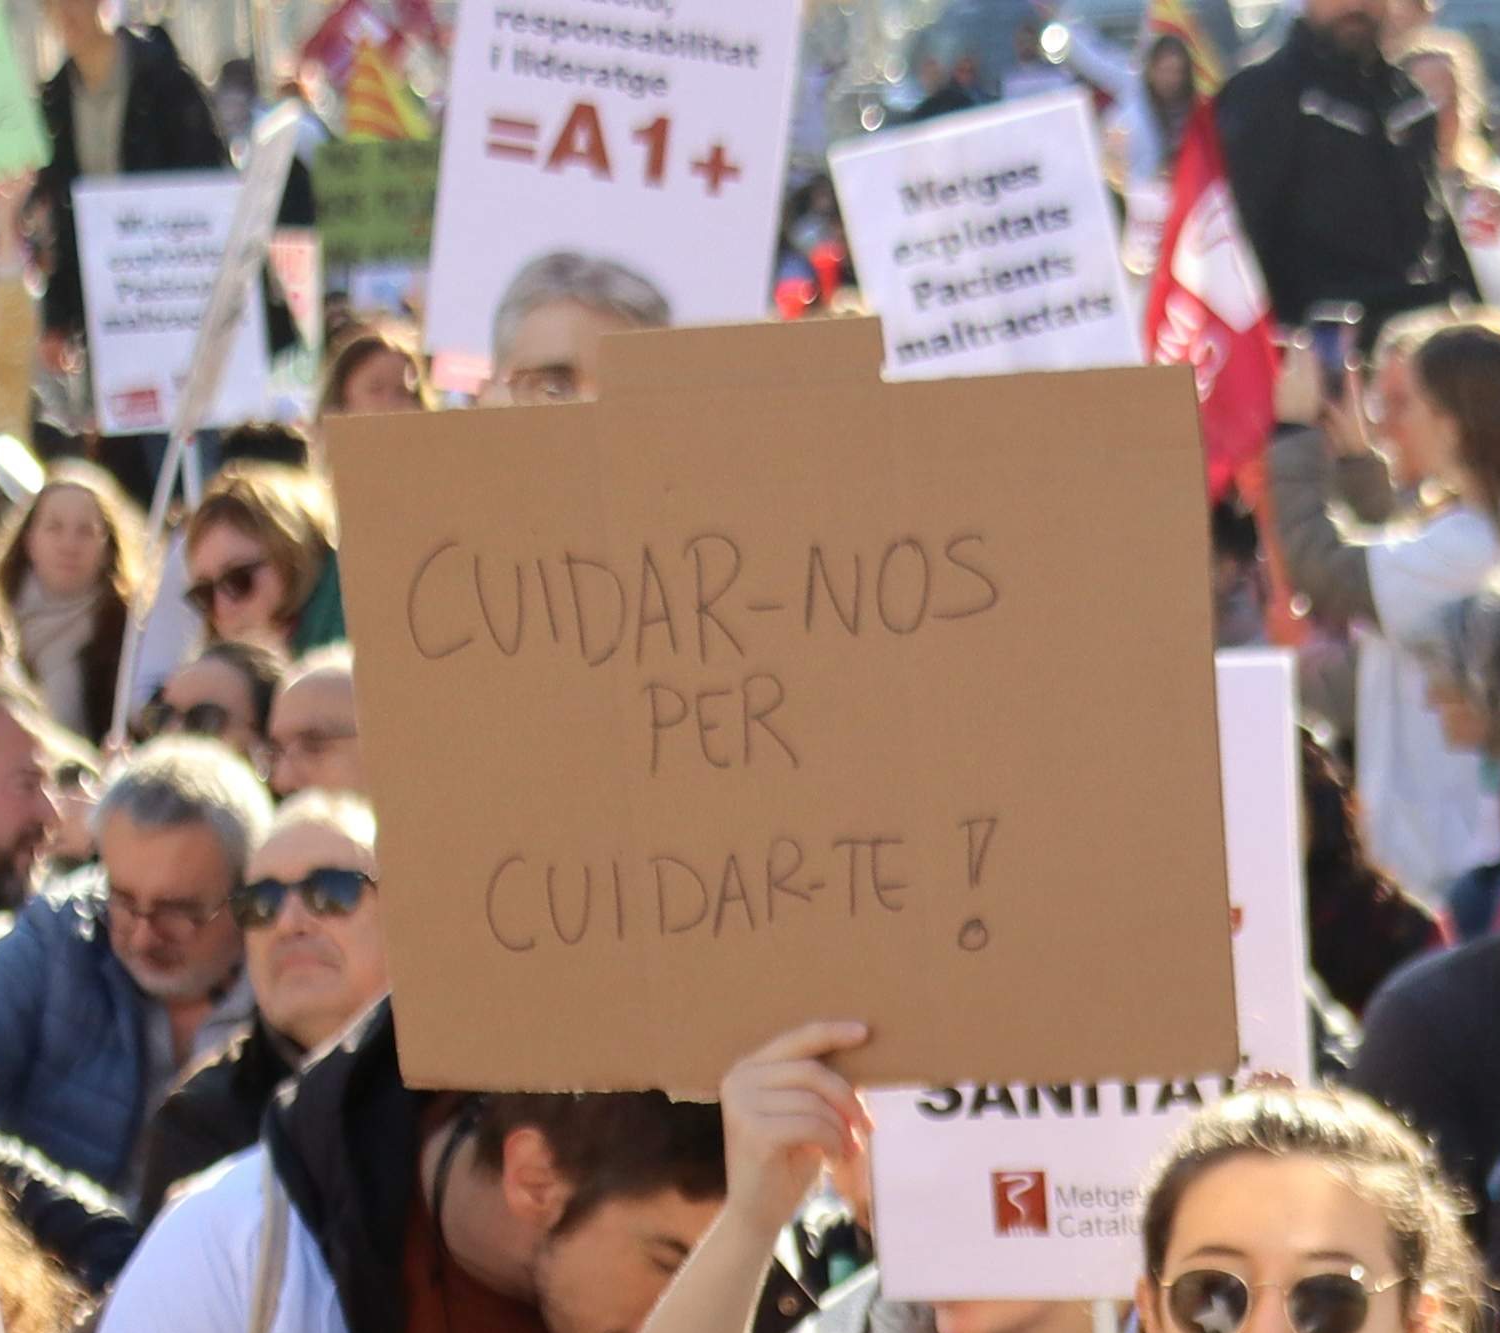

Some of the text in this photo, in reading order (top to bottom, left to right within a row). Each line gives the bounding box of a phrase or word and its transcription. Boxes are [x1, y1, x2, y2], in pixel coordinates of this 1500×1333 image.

[494, 9, 758, 69] responsabilitat
[513, 48, 669, 98] lideratge
[486, 101, 742, 198] =A1+
[898, 164, 1042, 215] Metges
[893, 206, 1071, 266] explotats
[912, 255, 1075, 312] Pacients
[895, 293, 1115, 365] maltractats
[405, 532, 999, 668] CUIDAR-NOS
[643, 673, 799, 777] PER
